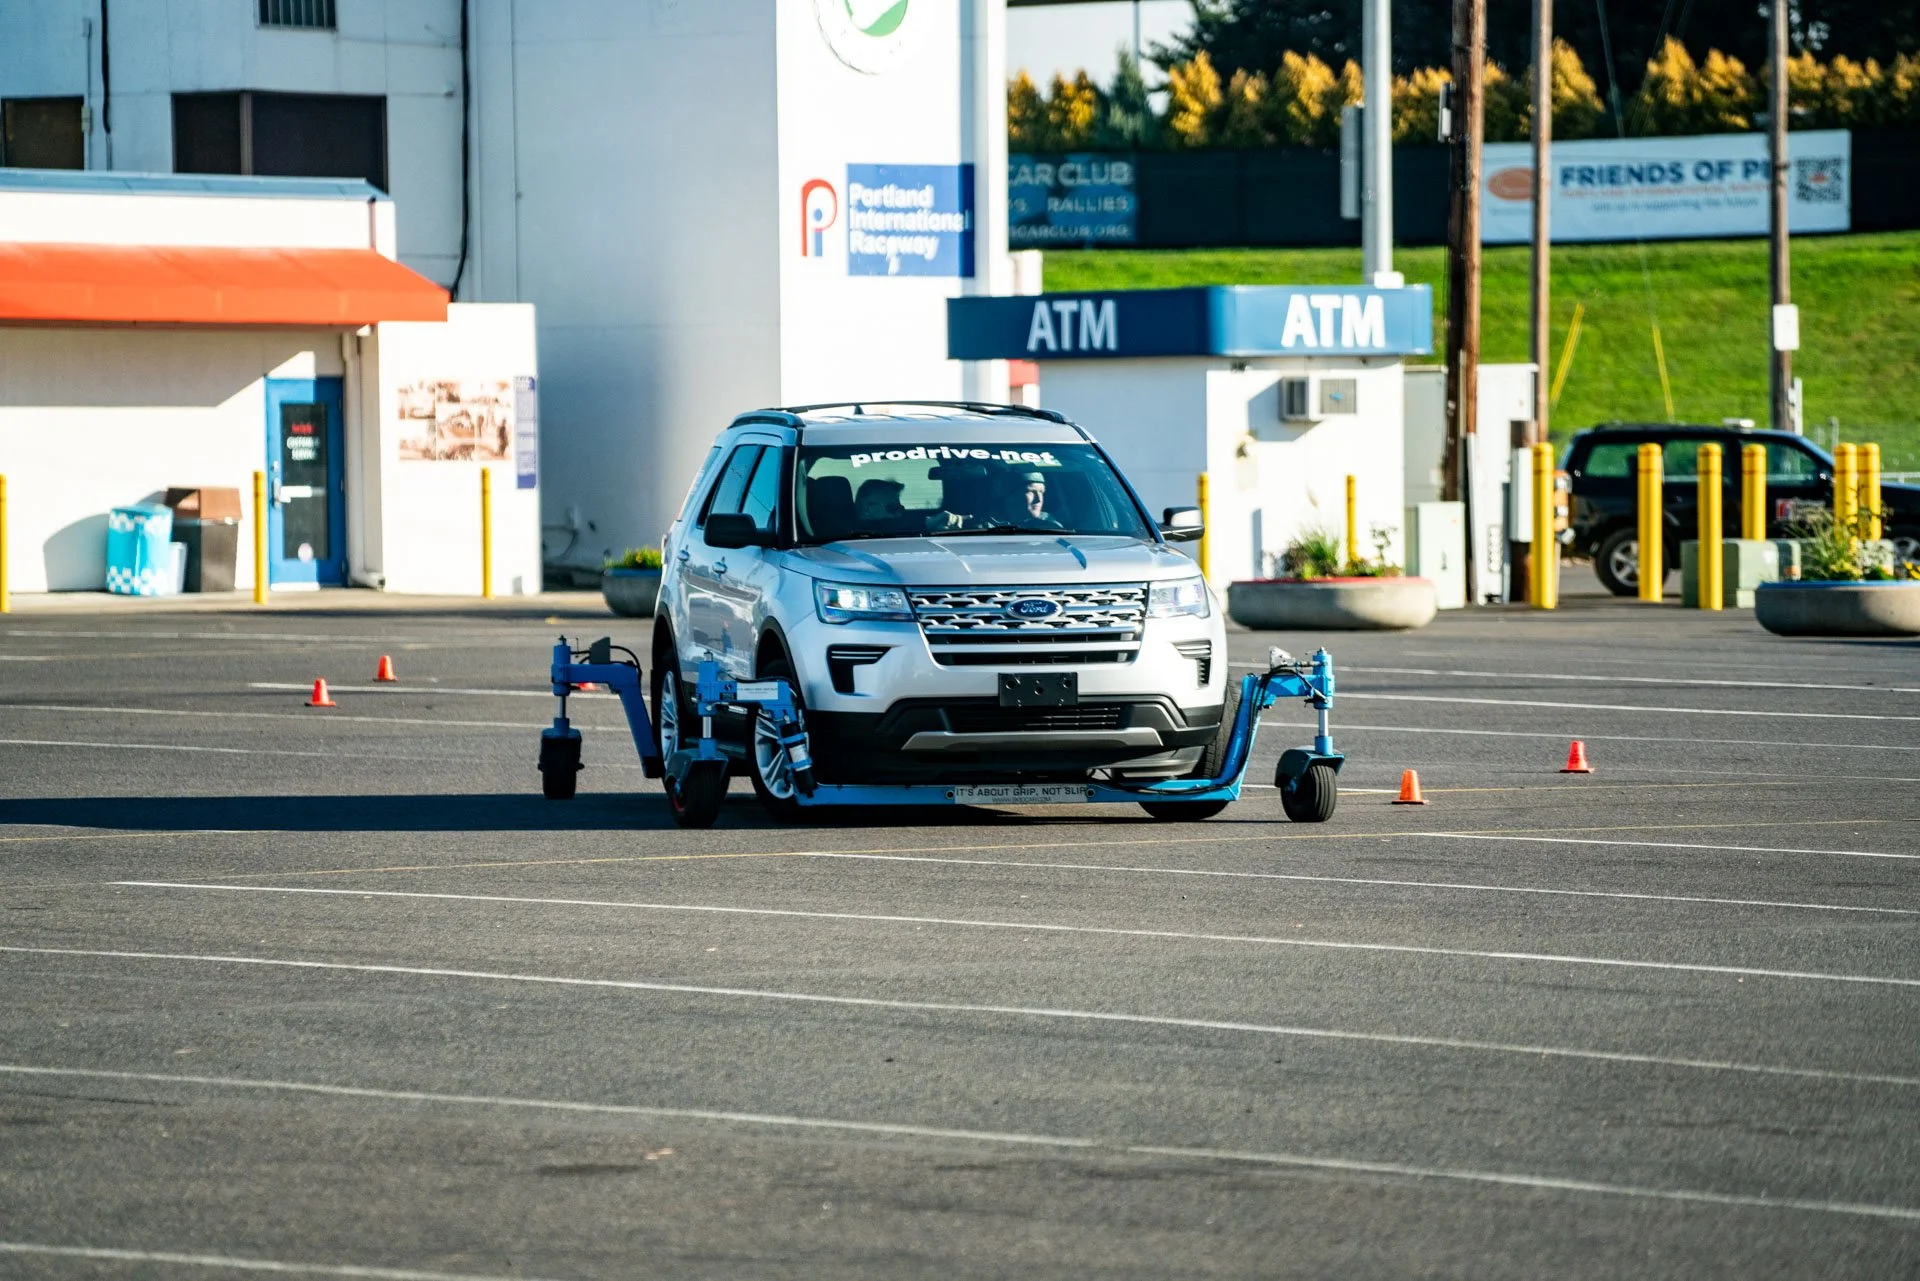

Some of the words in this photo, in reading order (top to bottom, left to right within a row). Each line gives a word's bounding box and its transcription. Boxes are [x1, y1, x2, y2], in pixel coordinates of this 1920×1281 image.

[1057, 160, 1135, 187] CLUB
[1560, 161, 1684, 187] FRIENDS
[1694, 160, 1734, 181] OF
[850, 183, 934, 208] Portland
[1047, 196, 1130, 213] RALLIES
[850, 208, 969, 232] International
[850, 231, 939, 261] Raceway
[1026, 299, 1118, 352] ATM
[1280, 294, 1386, 348] ATM
[850, 446, 1056, 468] prodrive.net
[1020, 602, 1049, 614] Ford
[956, 788, 974, 797] IT'S
[977, 788, 1009, 797] ABOUT
[1013, 788, 1039, 797] GRIP,
[1042, 787, 1062, 796] NOT
[1065, 786, 1086, 795] SLIP
